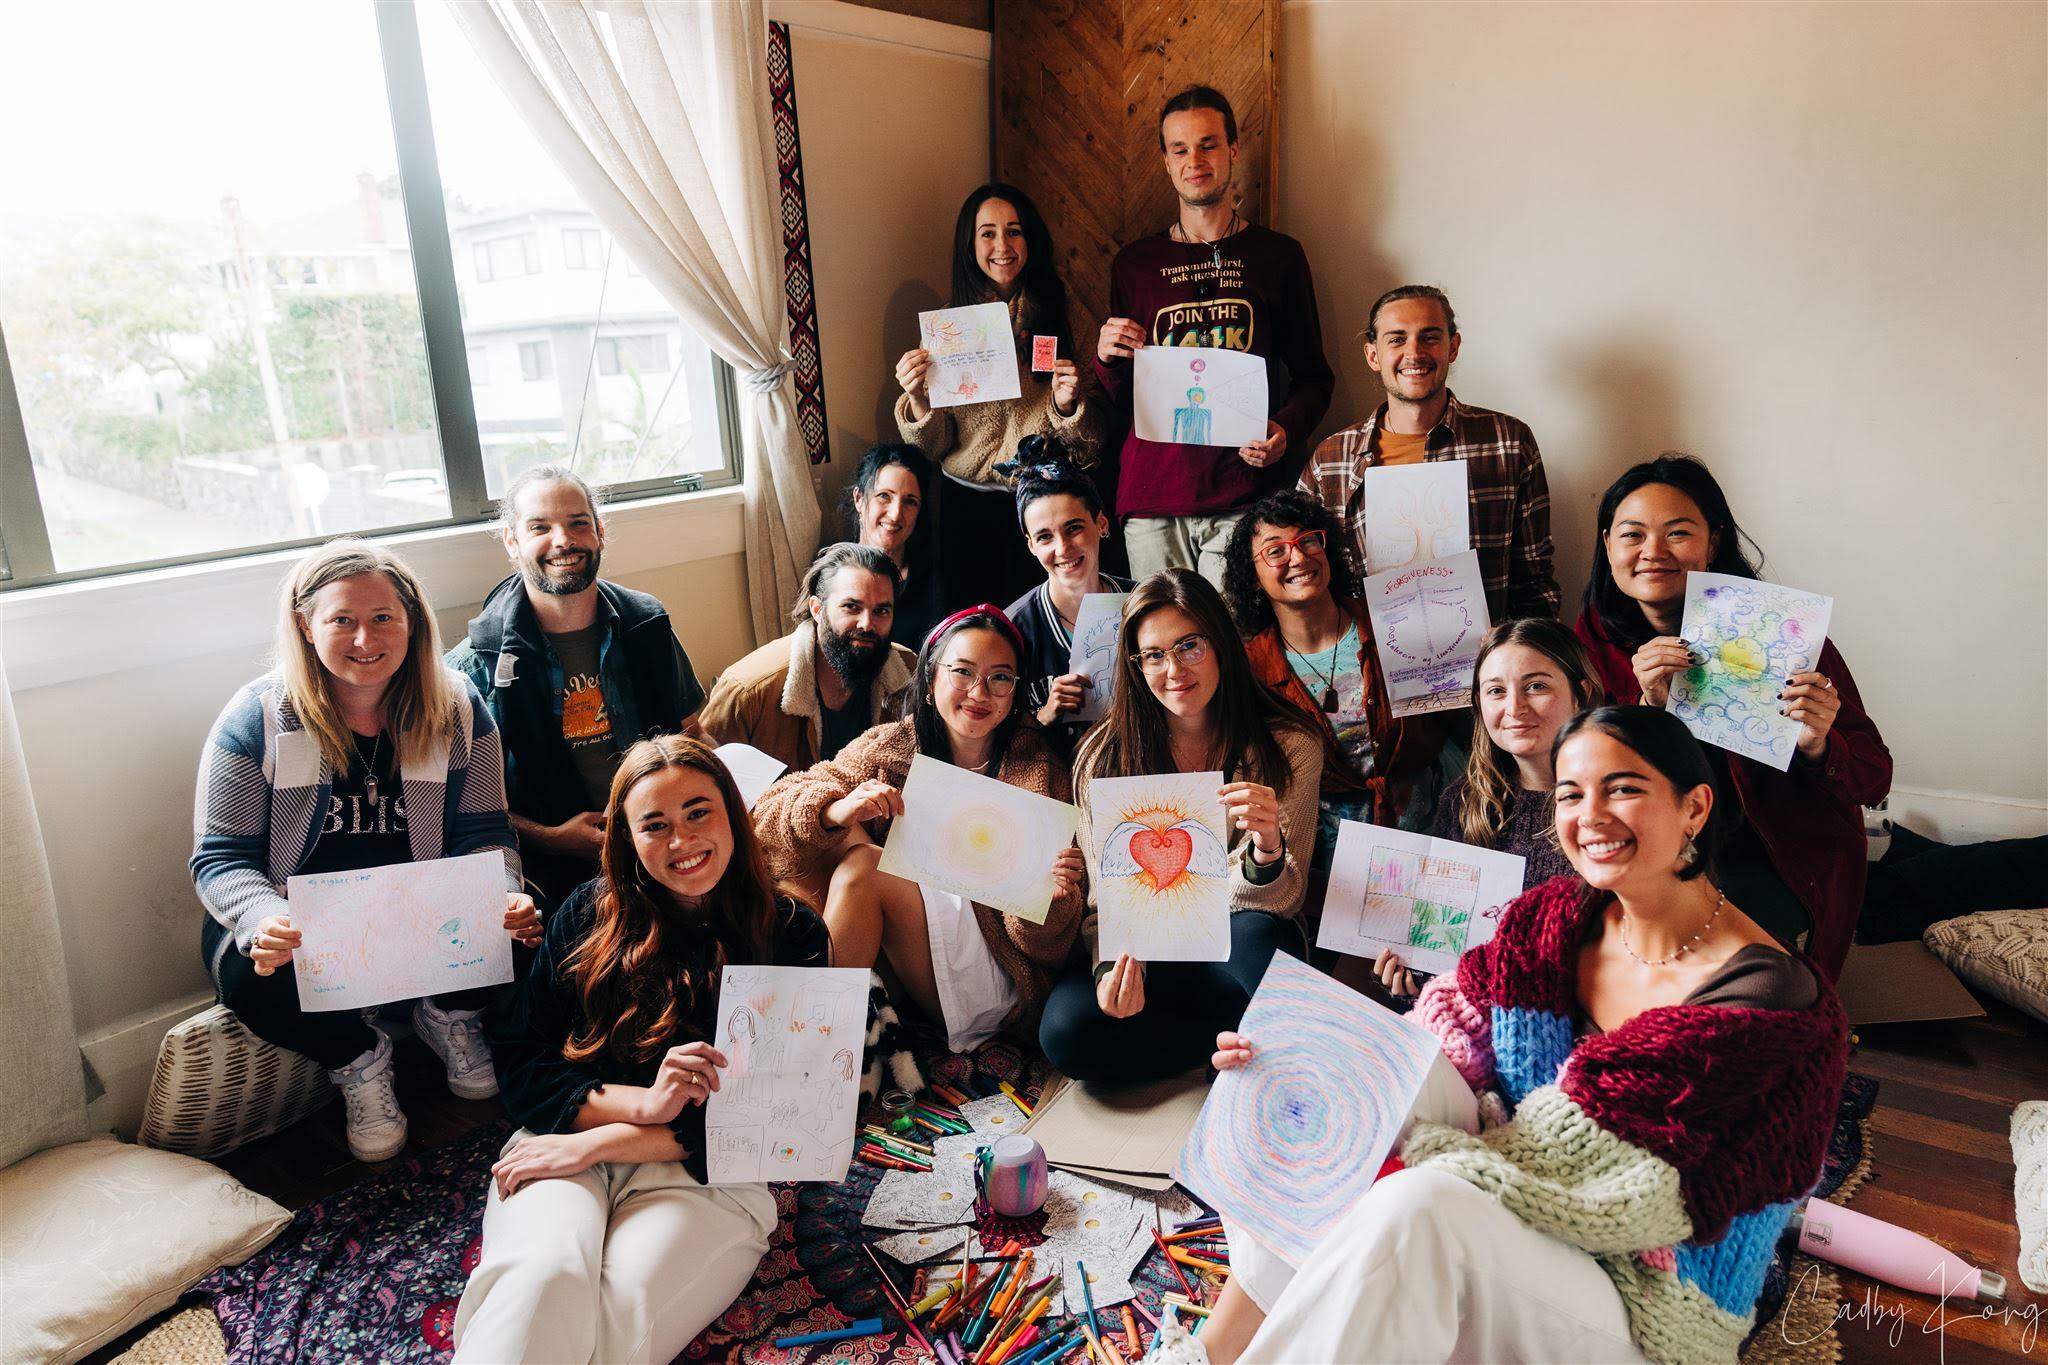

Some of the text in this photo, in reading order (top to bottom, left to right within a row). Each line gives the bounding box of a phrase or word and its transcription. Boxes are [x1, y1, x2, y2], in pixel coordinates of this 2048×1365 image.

[1160, 261, 1215, 276] Transmute
[1171, 269, 1241, 284] ask questions
[1220, 278, 1243, 288] later
[1168, 305, 1238, 330] JOIN THE
[1385, 566, 1449, 593] FORGIVENESS
